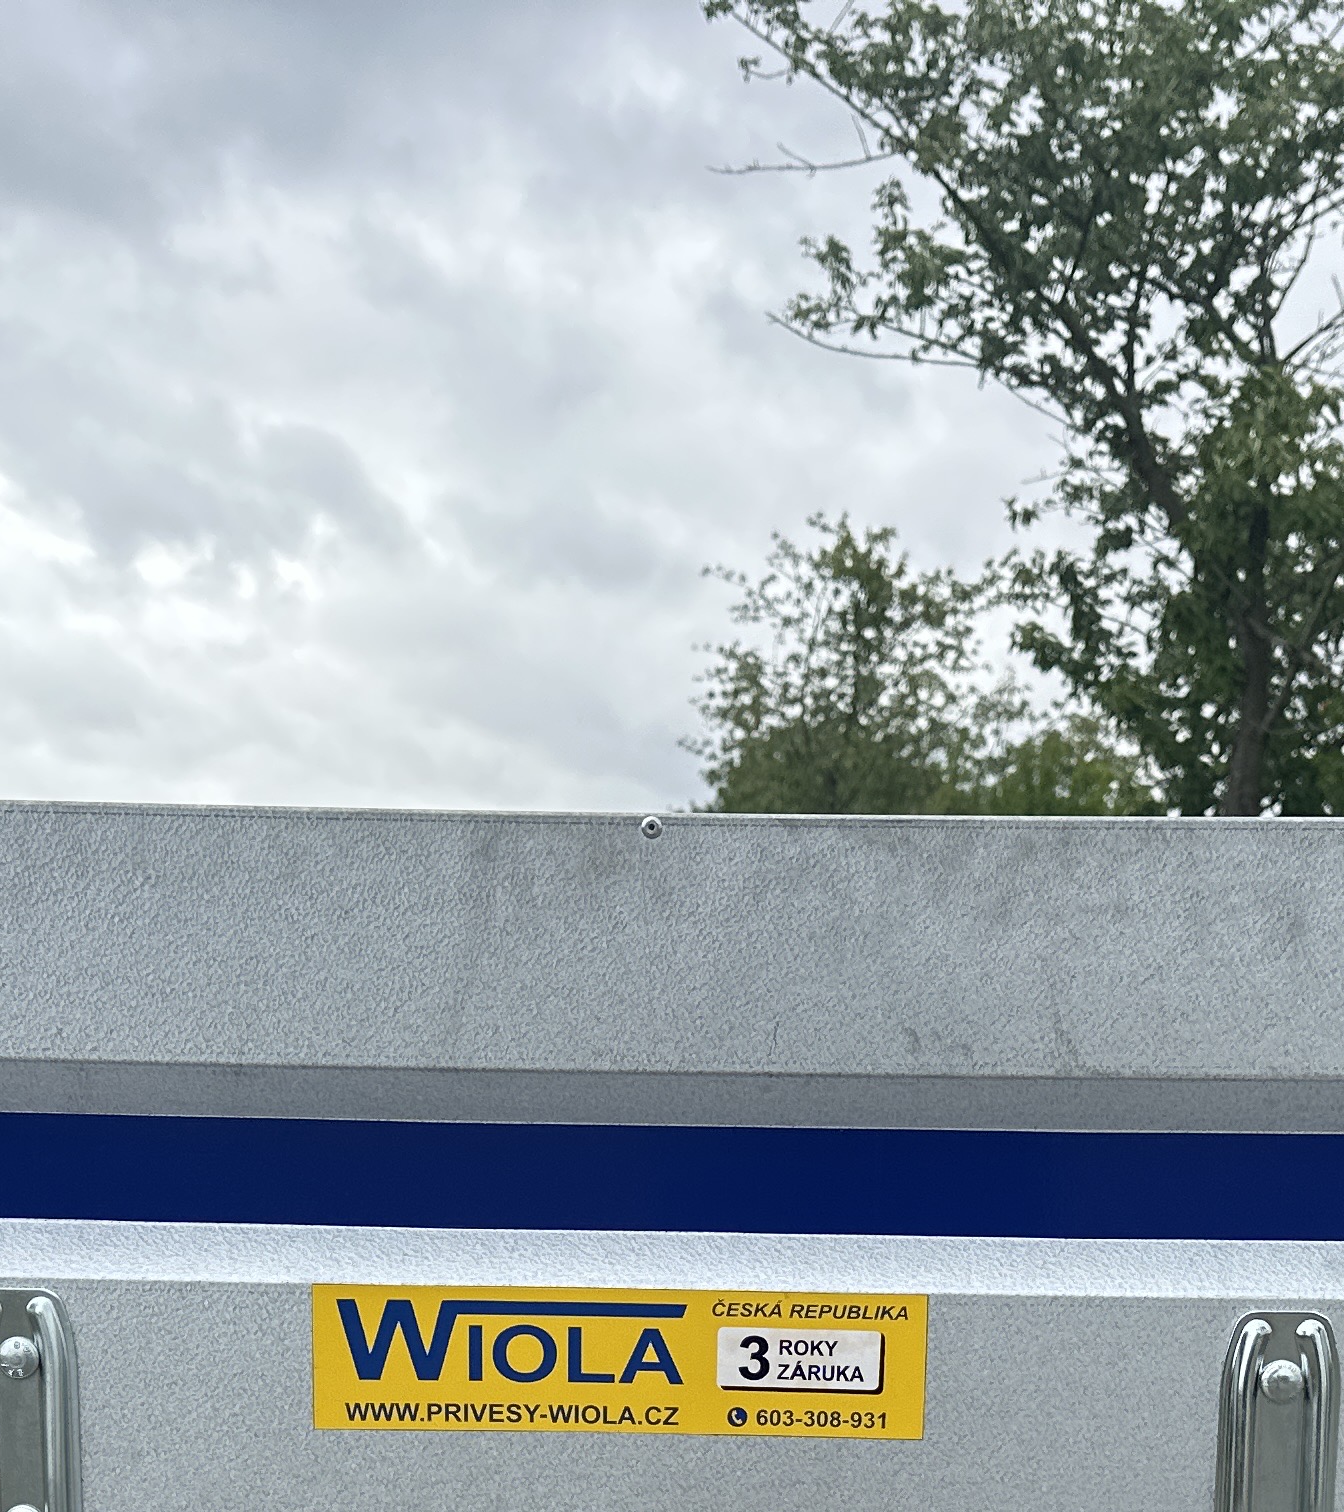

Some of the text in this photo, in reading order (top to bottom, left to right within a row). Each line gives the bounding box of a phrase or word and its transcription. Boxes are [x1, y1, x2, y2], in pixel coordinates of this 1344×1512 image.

[711, 1299, 909, 1321] ČESKÁ REPUBLIKA
[336, 1299, 687, 1385] WIOLA
[779, 1339, 839, 1357] ROKY
[738, 1335, 770, 1381] 3
[776, 1361, 864, 1383] ZÁRUKA
[344, 1402, 680, 1427] WWW.PRIVESY-WIOLA.CZ
[756, 1410, 887, 1430] 603-308-931
